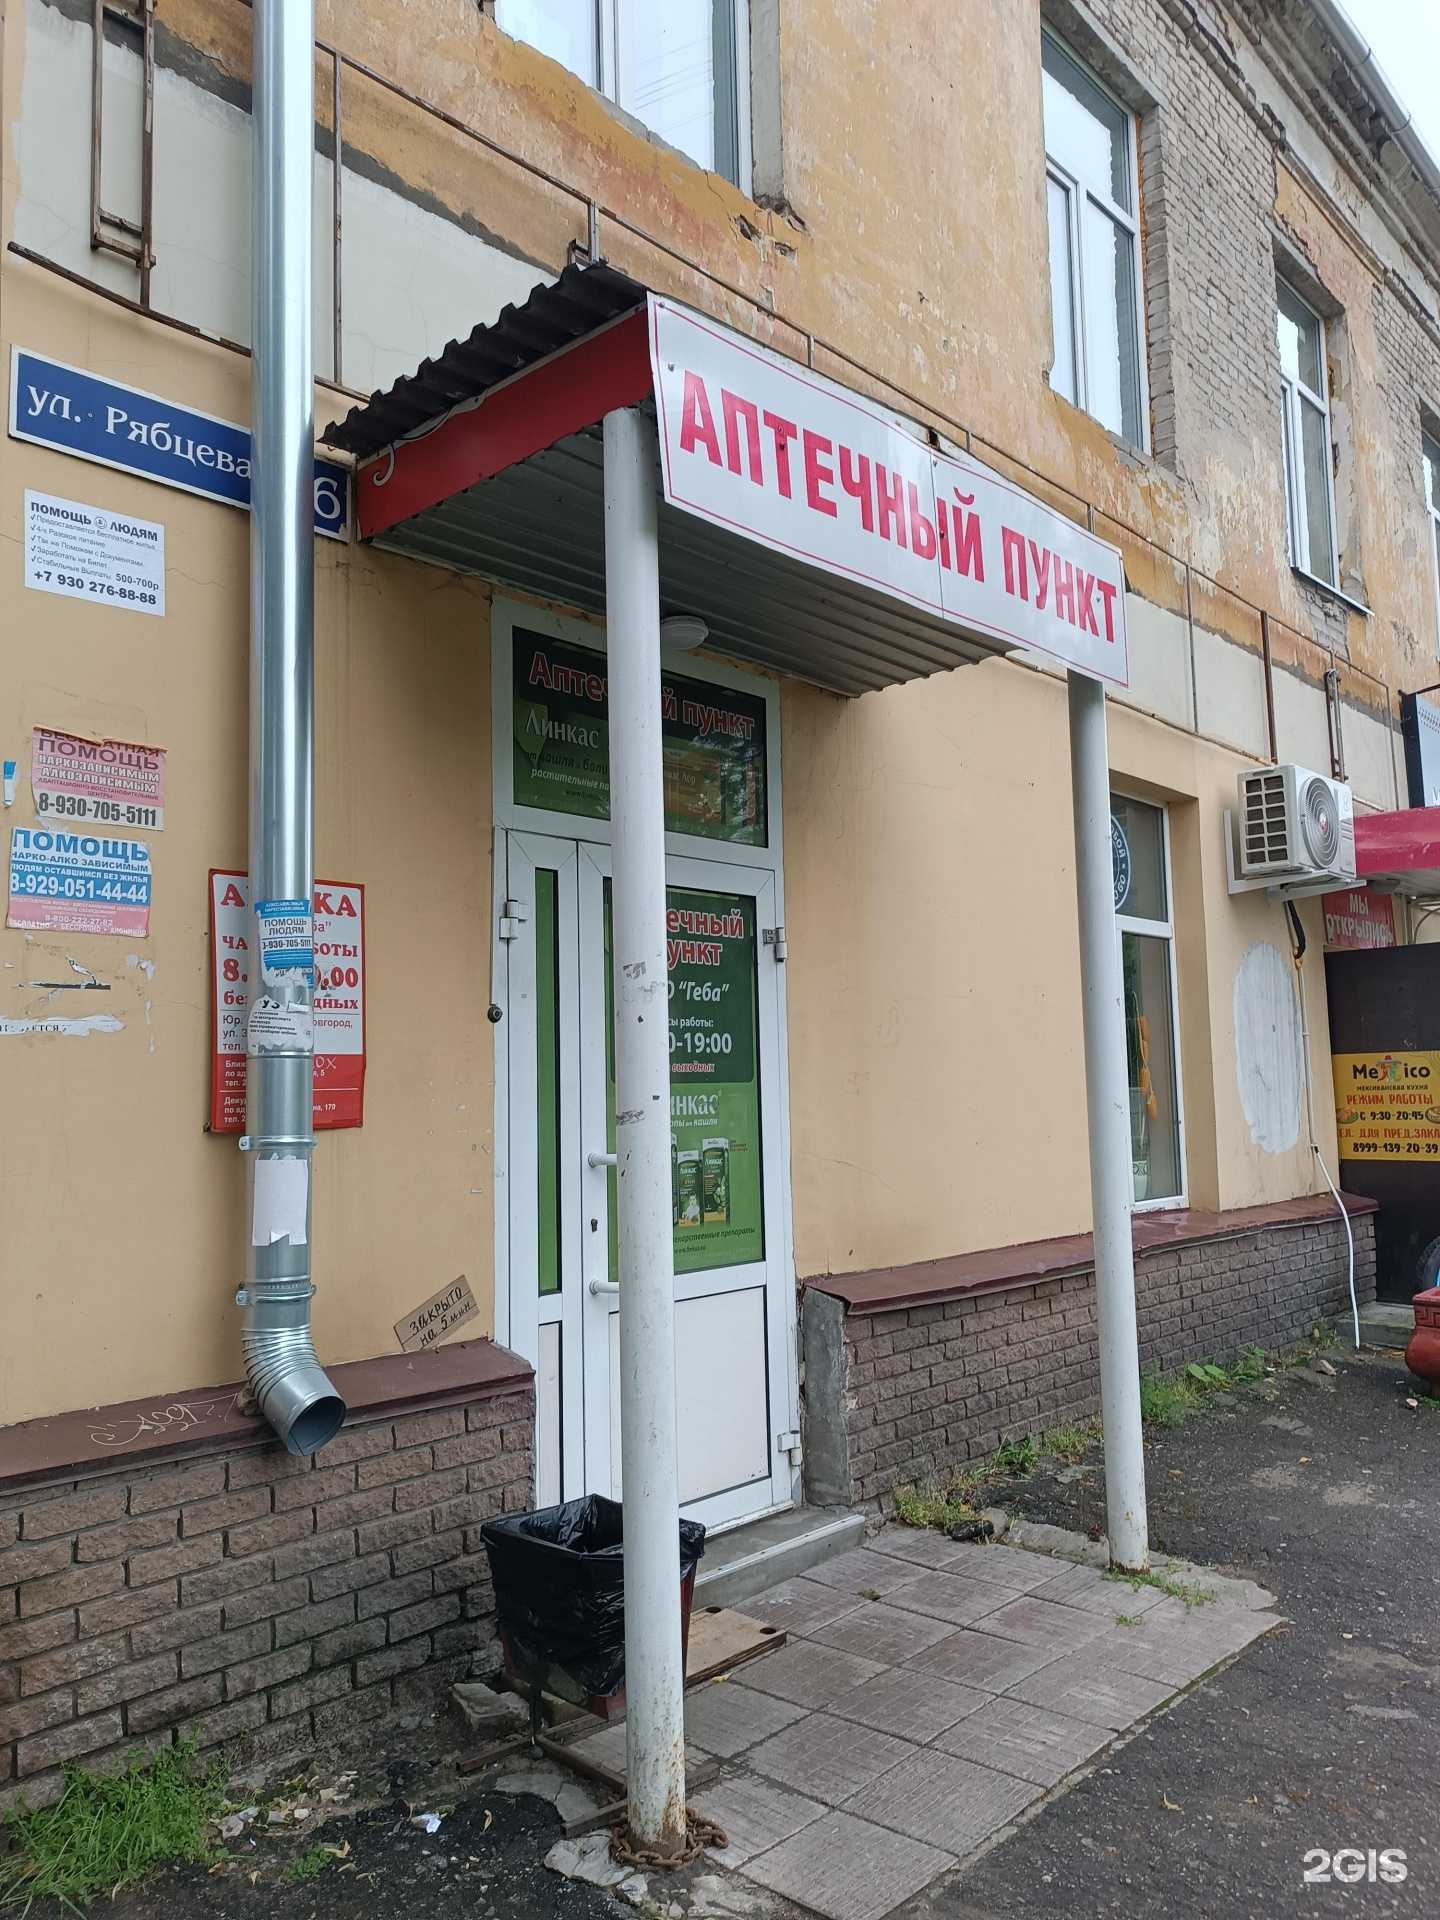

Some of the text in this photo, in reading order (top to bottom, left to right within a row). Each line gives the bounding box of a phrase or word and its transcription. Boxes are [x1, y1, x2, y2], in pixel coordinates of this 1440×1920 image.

[27, 384, 251, 479] ул. Рябцева
[314, 476, 341, 519] 6
[679, 369, 1117, 644] АПТЕЧНЫЙ ПУНКТ
[31, 502, 158, 542] ПОМОЩЬ ЛЮДЯМ
[34, 570, 157, 605] +7 930 276-88-88
[526, 706, 599, 749] Линкас
[683, 700, 755, 739] пункт
[39, 738, 159, 771] ПОМОЩЬ
[39, 754, 160, 783] НАРКОЗАВИСИМЫМ
[41, 766, 156, 793] АЛКОЗАВИСИМЫМ
[39, 792, 156, 827] 8-930-705-5111
[13, 829, 149, 863] ПОМОЩЬ
[81, 858, 149, 873] ЗАВИСИМЫМ
[103, 872, 118, 880] БЕЗ
[120, 874, 148, 884] ЖИЛЬЯ
[11, 872, 148, 904] 8-929-051-44-44
[264, 918, 307, 928] ПОМОЩЬ
[269, 926, 305, 936] ЛЮДЯМ
[666, 908, 744, 939] ечный
[667, 938, 723, 971] ункт
[313, 998, 358, 1011] дных
[313, 1018, 353, 1029] овгород,
[671, 1094, 719, 1116] нкас
[1346, 1094, 1433, 1105] РЕЖИМ РАБОТЫ
[1338, 1128, 1353, 1138] ЕЛ.
[1360, 1128, 1380, 1139] ДЛЯ
[440, 1314, 448, 1331] 5
